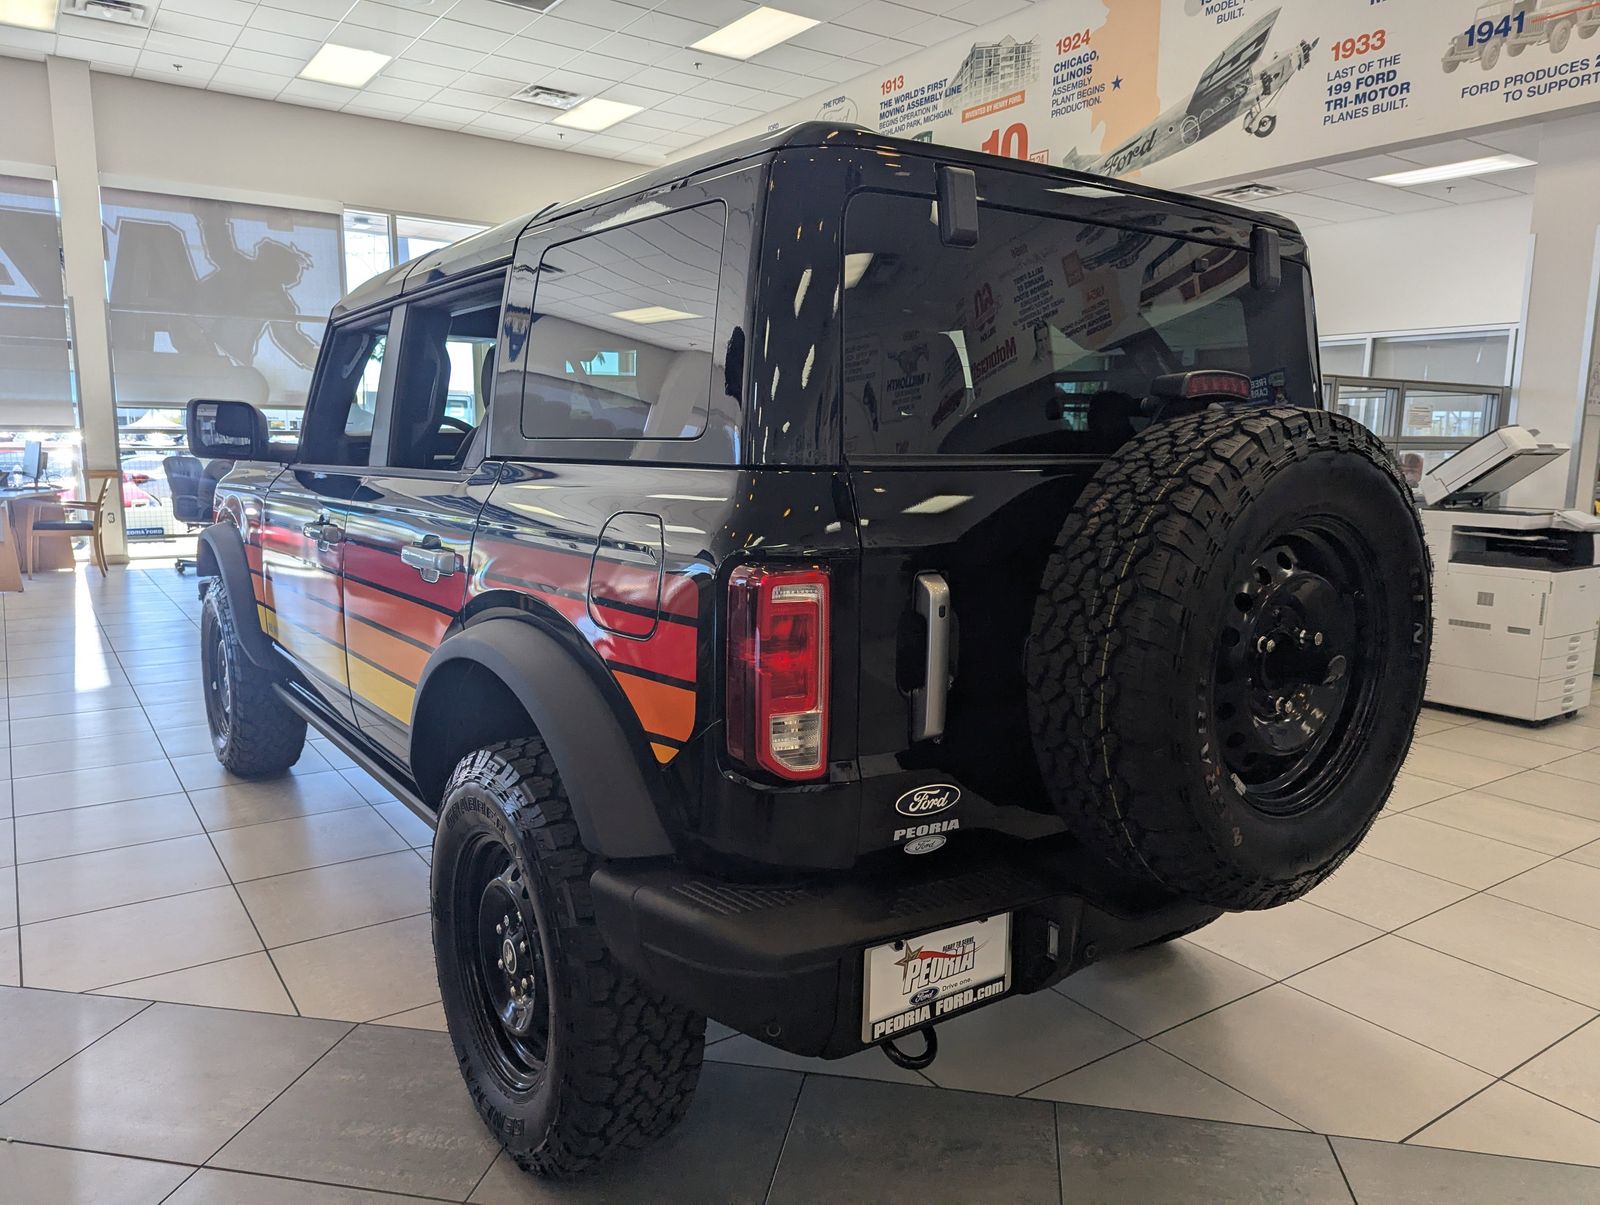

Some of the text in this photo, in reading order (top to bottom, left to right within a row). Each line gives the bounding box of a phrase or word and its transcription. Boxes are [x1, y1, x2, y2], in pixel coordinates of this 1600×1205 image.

[1205, 0, 1240, 16] MODEL
[1216, 7, 1245, 25] BUILT.
[1056, 28, 1091, 56] 1924
[1464, 10, 1526, 47] 1941
[1330, 29, 1387, 62] 1933
[1052, 64, 1093, 86] ILLINOIS
[1053, 50, 1100, 74] CHICAGO,
[1326, 53, 1402, 82] LAST OF THE
[880, 74, 905, 96] 1913
[1051, 76, 1093, 98] ASSEMBLY
[1326, 69, 1398, 98] 199 FORD
[1461, 80, 1500, 99] FORD
[1503, 58, 1591, 89] PRODUCES
[1503, 71, 1600, 103] TO SUPPORT
[832, 95, 846, 106] FORD
[879, 78, 949, 111] THE WORLD'S FIRST
[879, 83, 962, 121] MOVING ASSEMBLY LINE
[1050, 95, 1102, 119] PRODUCTION.
[1051, 82, 1106, 108] PLANT BEGINS
[1324, 81, 1411, 113] TRI-MOTOR
[879, 103, 938, 130] BEGINS OPERATION IN
[906, 118, 922, 130] PARK,
[923, 107, 953, 123] MICHIGAN.
[1322, 97, 1410, 126] PLANES BUILT.
[1102, 127, 1158, 177] Ford
[908, 788, 950, 813] Ford
[893, 818, 960, 841] PEORIA
[914, 839, 936, 851] Ford
[902, 941, 976, 996] PEORIA
[914, 988, 935, 1003] Ford
[942, 981, 958, 992] Drive
[959, 977, 973, 986] one.
[873, 980, 1004, 1040] PEORIA FORD.com
